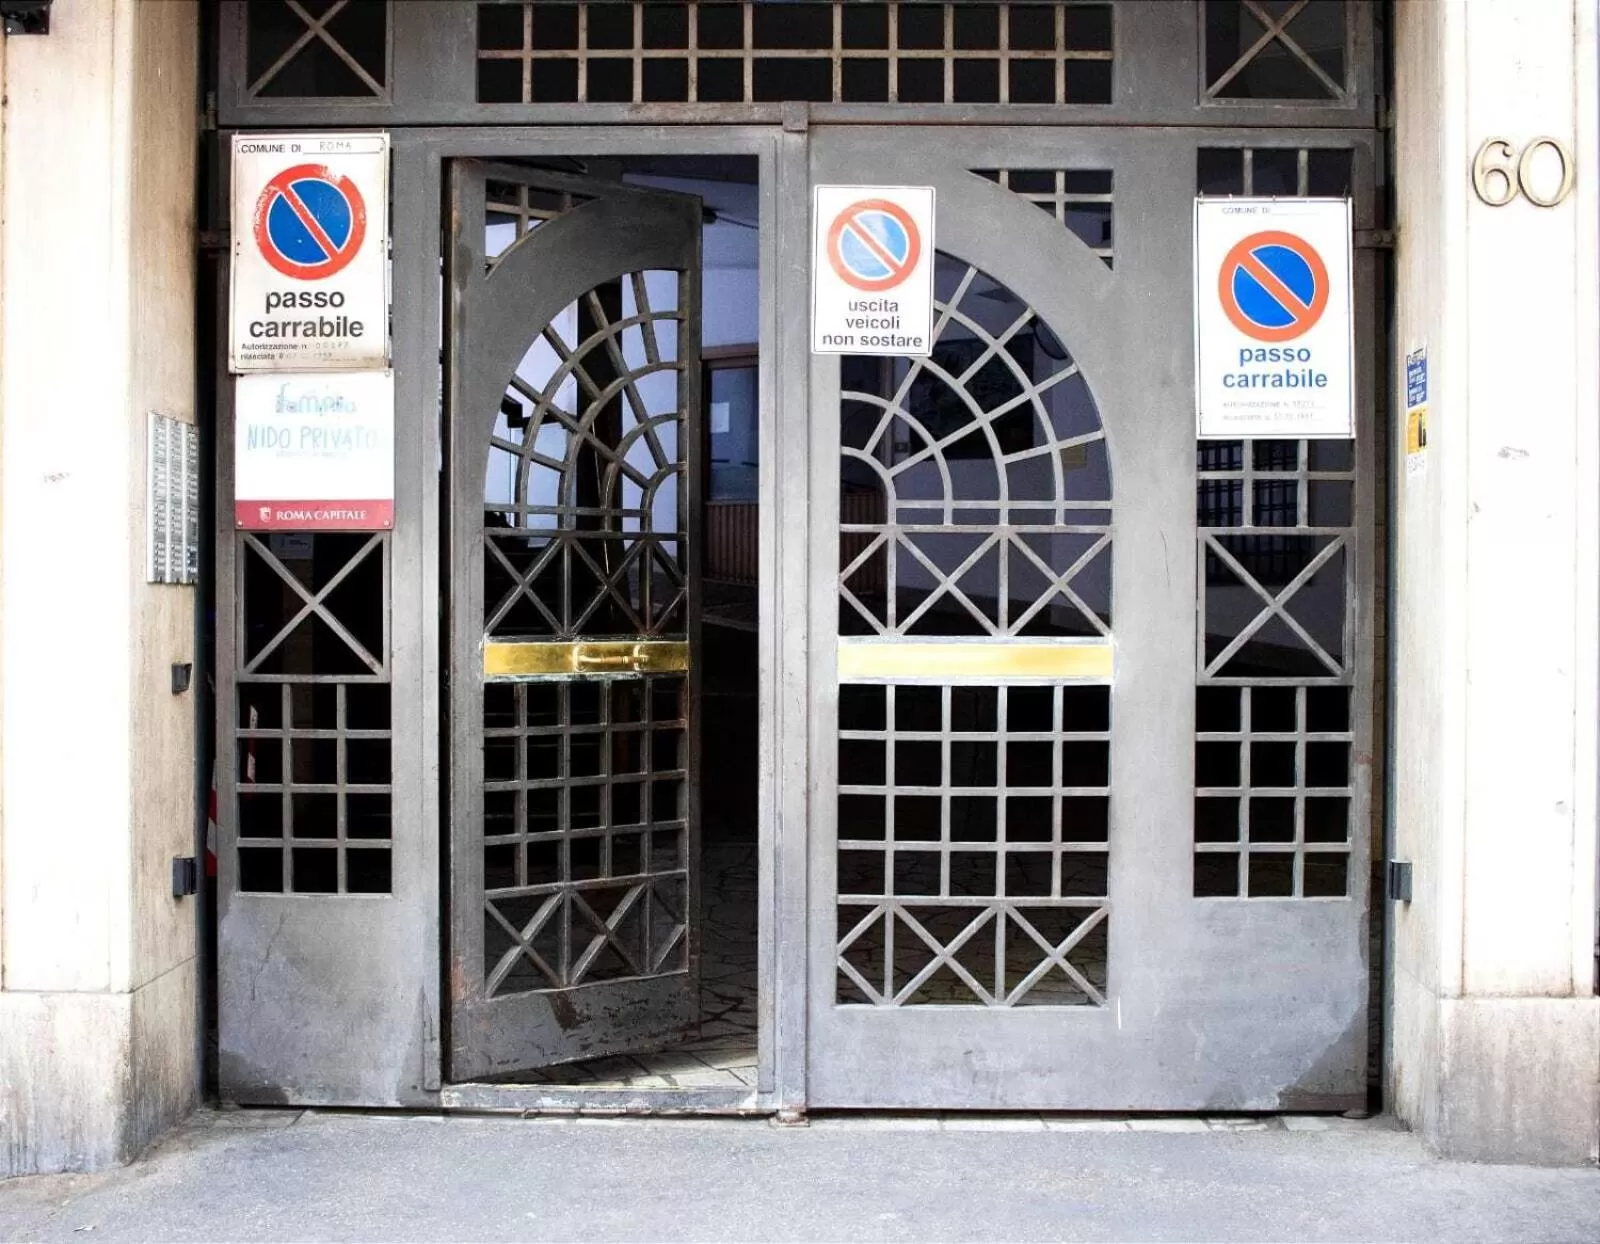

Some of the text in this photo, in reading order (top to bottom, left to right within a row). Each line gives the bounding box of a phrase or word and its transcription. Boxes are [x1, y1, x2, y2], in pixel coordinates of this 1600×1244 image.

[241, 141, 352, 153] COMUNE DI ROMA
[1472, 137, 1574, 207] 60
[1222, 207, 1257, 215] COMUNE
[265, 291, 345, 314] passo
[848, 299, 899, 312] uscita
[249, 316, 364, 338] carrabile
[846, 316, 900, 329] veicoli
[241, 343, 298, 351] Autorizzazione
[822, 334, 923, 347] non sostare
[1239, 348, 1311, 366] passo
[1223, 369, 1328, 388] carrabile
[247, 424, 378, 451] NIDO PRIVATO
[276, 510, 367, 520] ROMA CAPITALE
